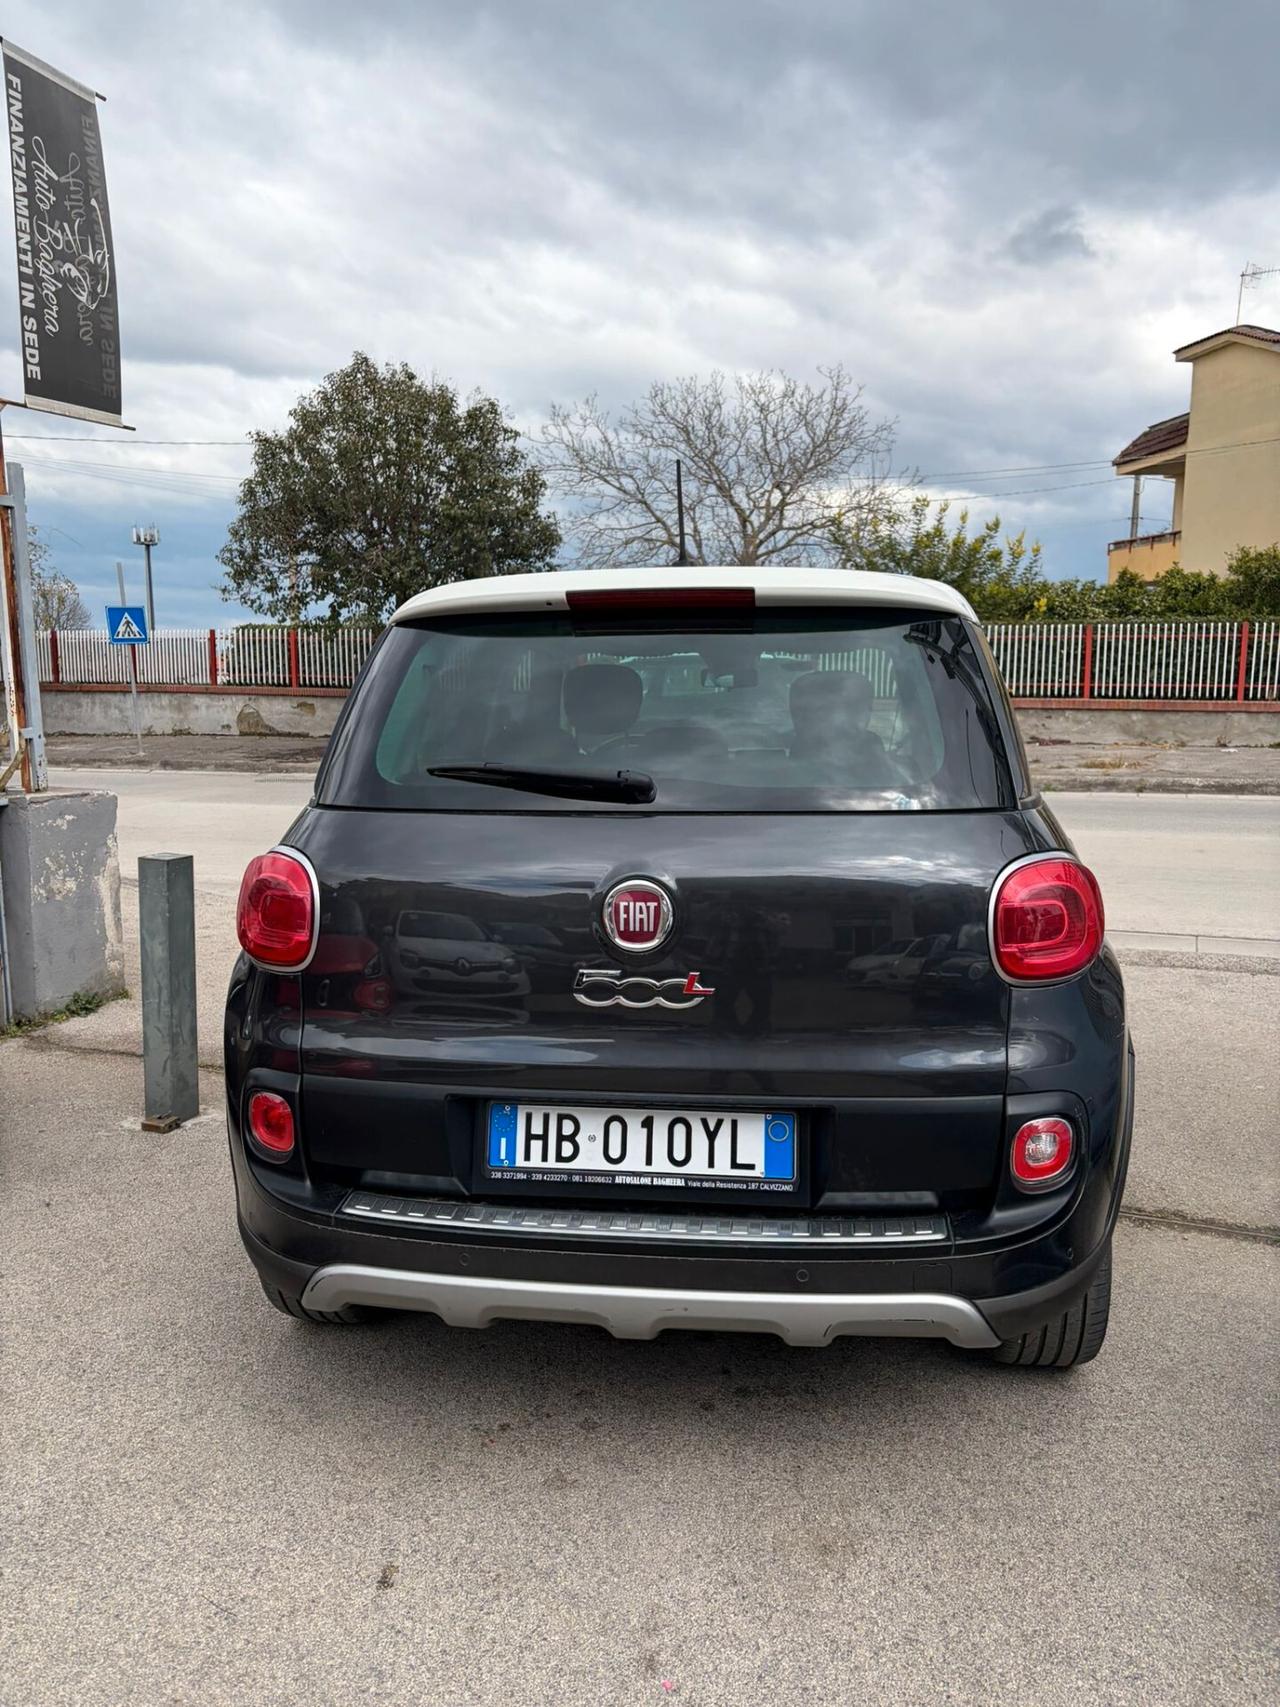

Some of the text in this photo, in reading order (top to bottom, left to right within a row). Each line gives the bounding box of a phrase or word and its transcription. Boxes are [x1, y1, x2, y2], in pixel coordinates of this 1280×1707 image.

[7, 73, 42, 381] FINANZIAMENTI IN SEDE
[31, 136, 64, 337] Auto Baghera
[619, 901, 658, 932] FIAT
[573, 969, 716, 1009] 500L
[614, 1175, 652, 1185] AUTOSALONE
[653, 1177, 686, 1186] BAGHEERA
[702, 1180, 715, 1188] della
[716, 1181, 747, 1190] Resistenza
[760, 1182, 794, 1192] CALVIZZANO
